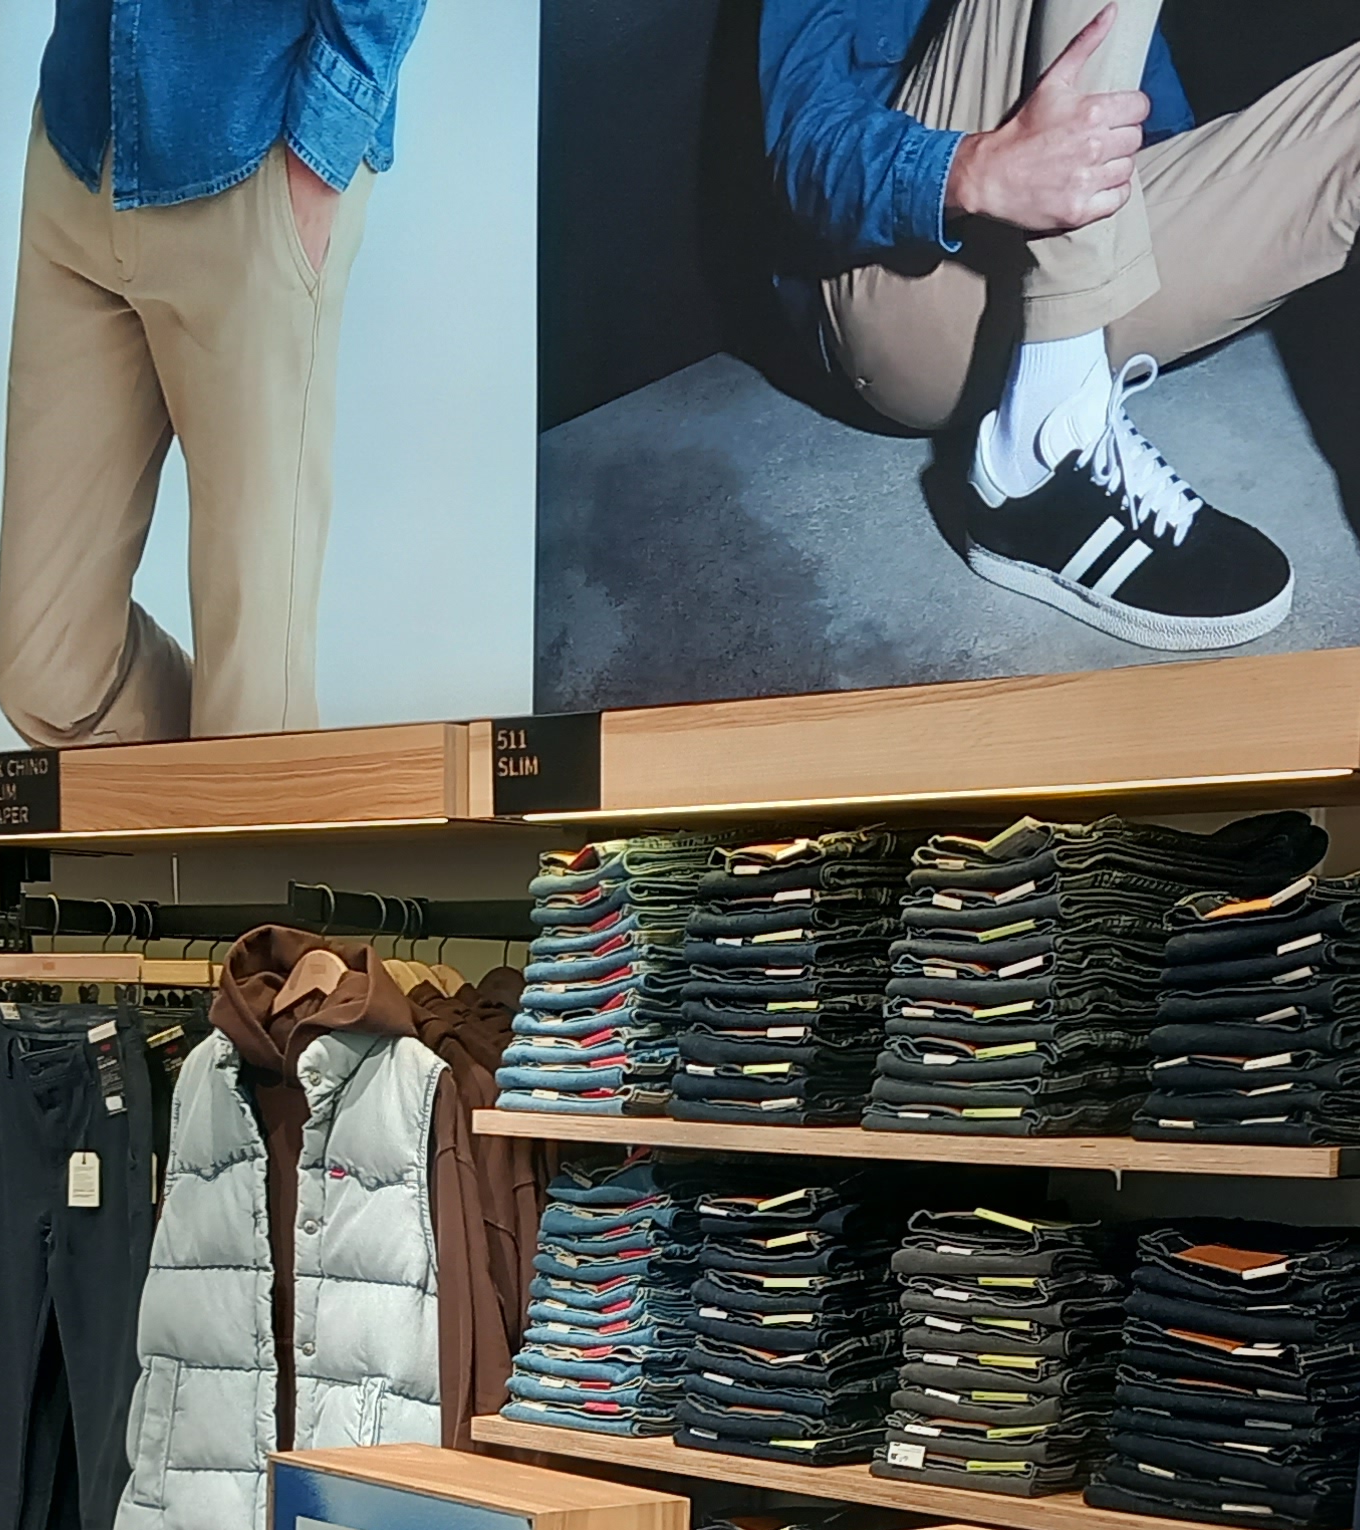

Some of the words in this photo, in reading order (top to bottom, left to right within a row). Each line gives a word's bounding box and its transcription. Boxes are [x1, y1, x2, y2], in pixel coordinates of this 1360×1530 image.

[497, 729, 527, 750] 511
[7, 757, 49, 777] CHINO
[497, 755, 539, 777] SLIM
